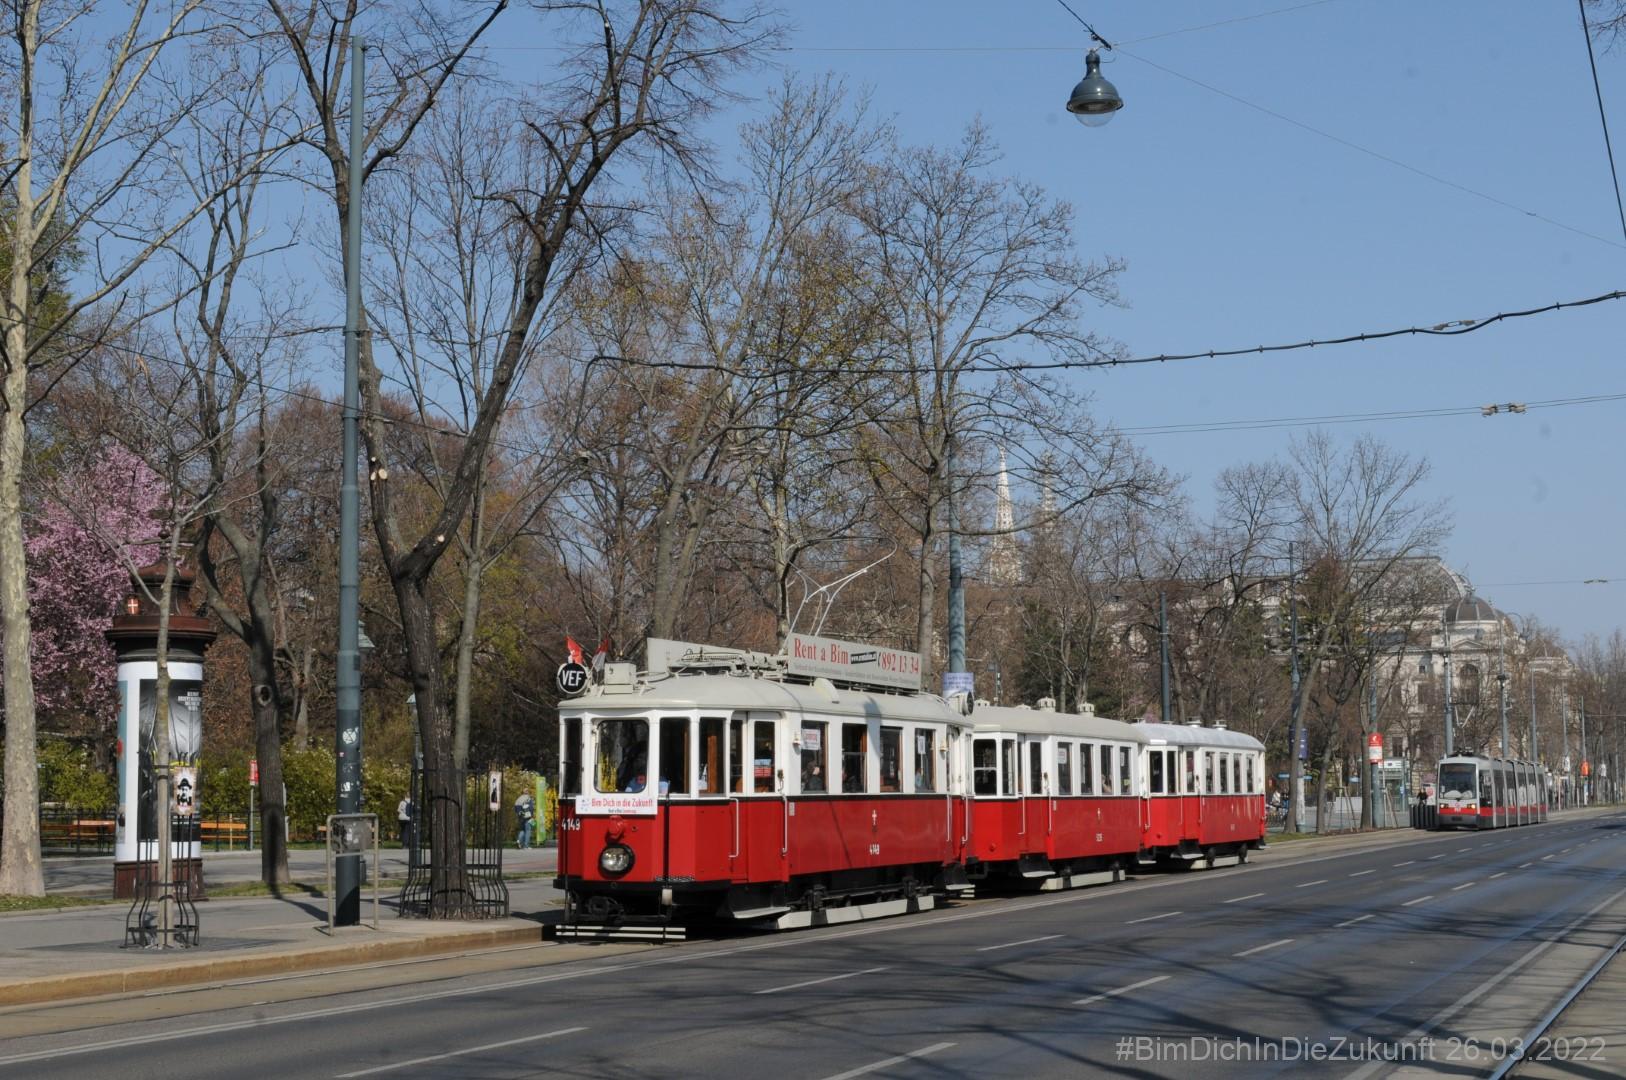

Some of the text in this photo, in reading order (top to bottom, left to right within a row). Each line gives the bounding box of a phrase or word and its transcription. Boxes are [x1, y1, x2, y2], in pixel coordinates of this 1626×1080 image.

[794, 638, 817, 661] Rent
[821, 647, 826, 661] a
[830, 643, 849, 665] Bim
[881, 651, 896, 672] 892
[899, 655, 907, 673] 13
[911, 655, 919, 674] 34
[562, 670, 585, 686] VEF
[591, 798, 602, 807] Bim
[603, 798, 615, 807] Dich
[622, 798, 631, 807] die
[632, 798, 653, 808] Zukunft
[561, 818, 581, 831] 4149
